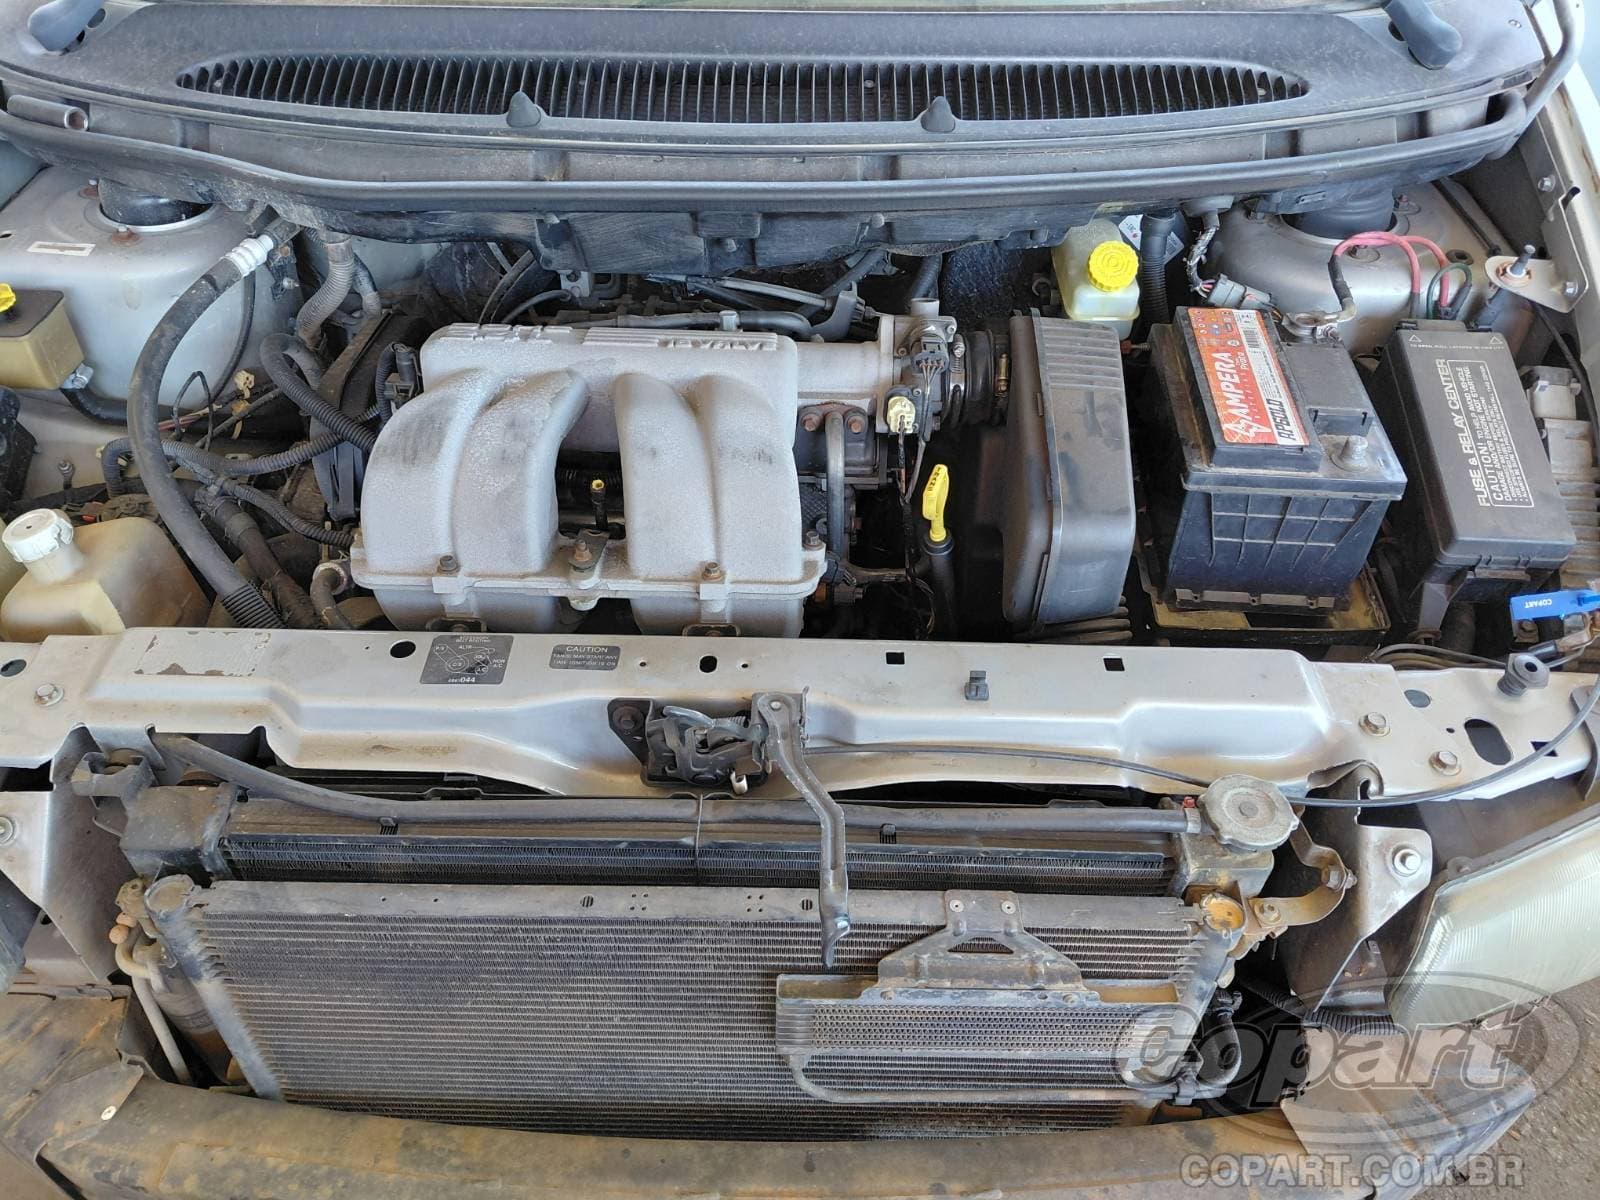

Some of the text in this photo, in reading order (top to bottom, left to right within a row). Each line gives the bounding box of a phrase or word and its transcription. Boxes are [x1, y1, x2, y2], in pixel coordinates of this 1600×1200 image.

[1212, 351, 1253, 421] AMPERA
[1435, 358, 1491, 507] FUSE & RELAY CENTER
[1476, 442, 1504, 501] CAUTION!
[1496, 470, 1512, 501] DAMAGE
[1524, 597, 1553, 609] COPART
[566, 645, 608, 653] CAUTION
